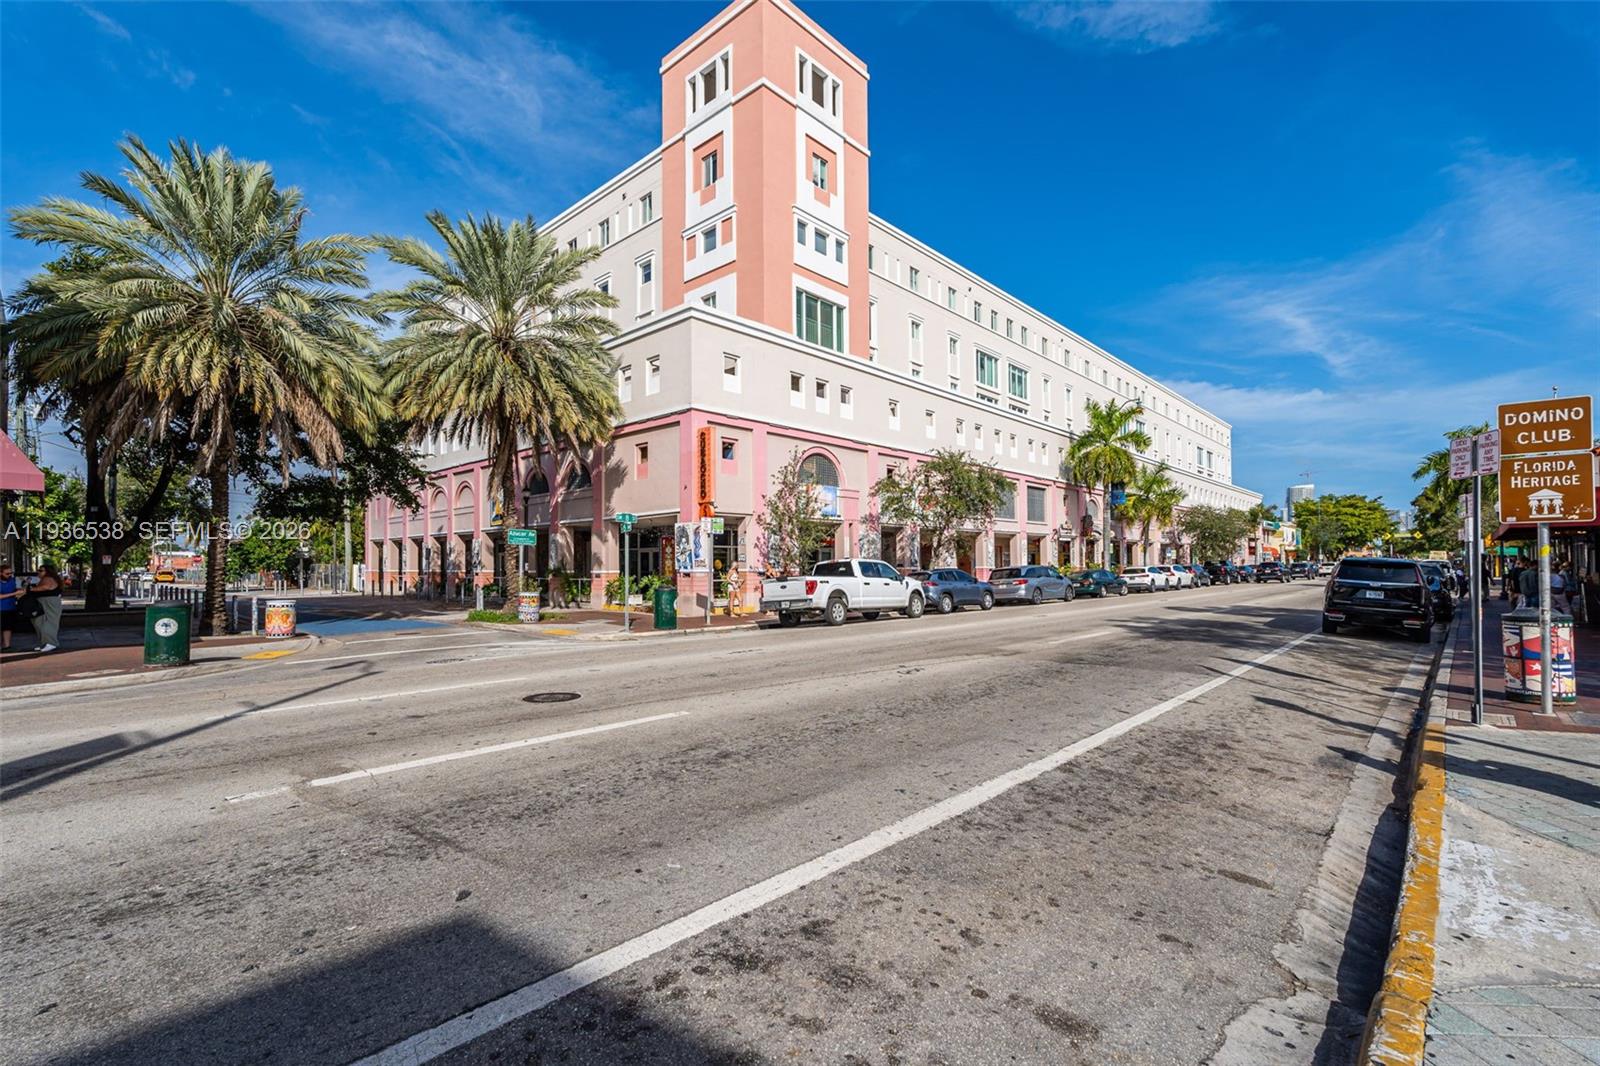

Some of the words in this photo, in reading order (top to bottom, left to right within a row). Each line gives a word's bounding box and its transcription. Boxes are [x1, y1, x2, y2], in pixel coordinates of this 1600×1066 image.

[1504, 407, 1584, 426] DOMINO
[1517, 428, 1571, 445] CLUB
[1513, 460, 1576, 474] FLORIDA
[1511, 474, 1581, 488] HERITAGE
